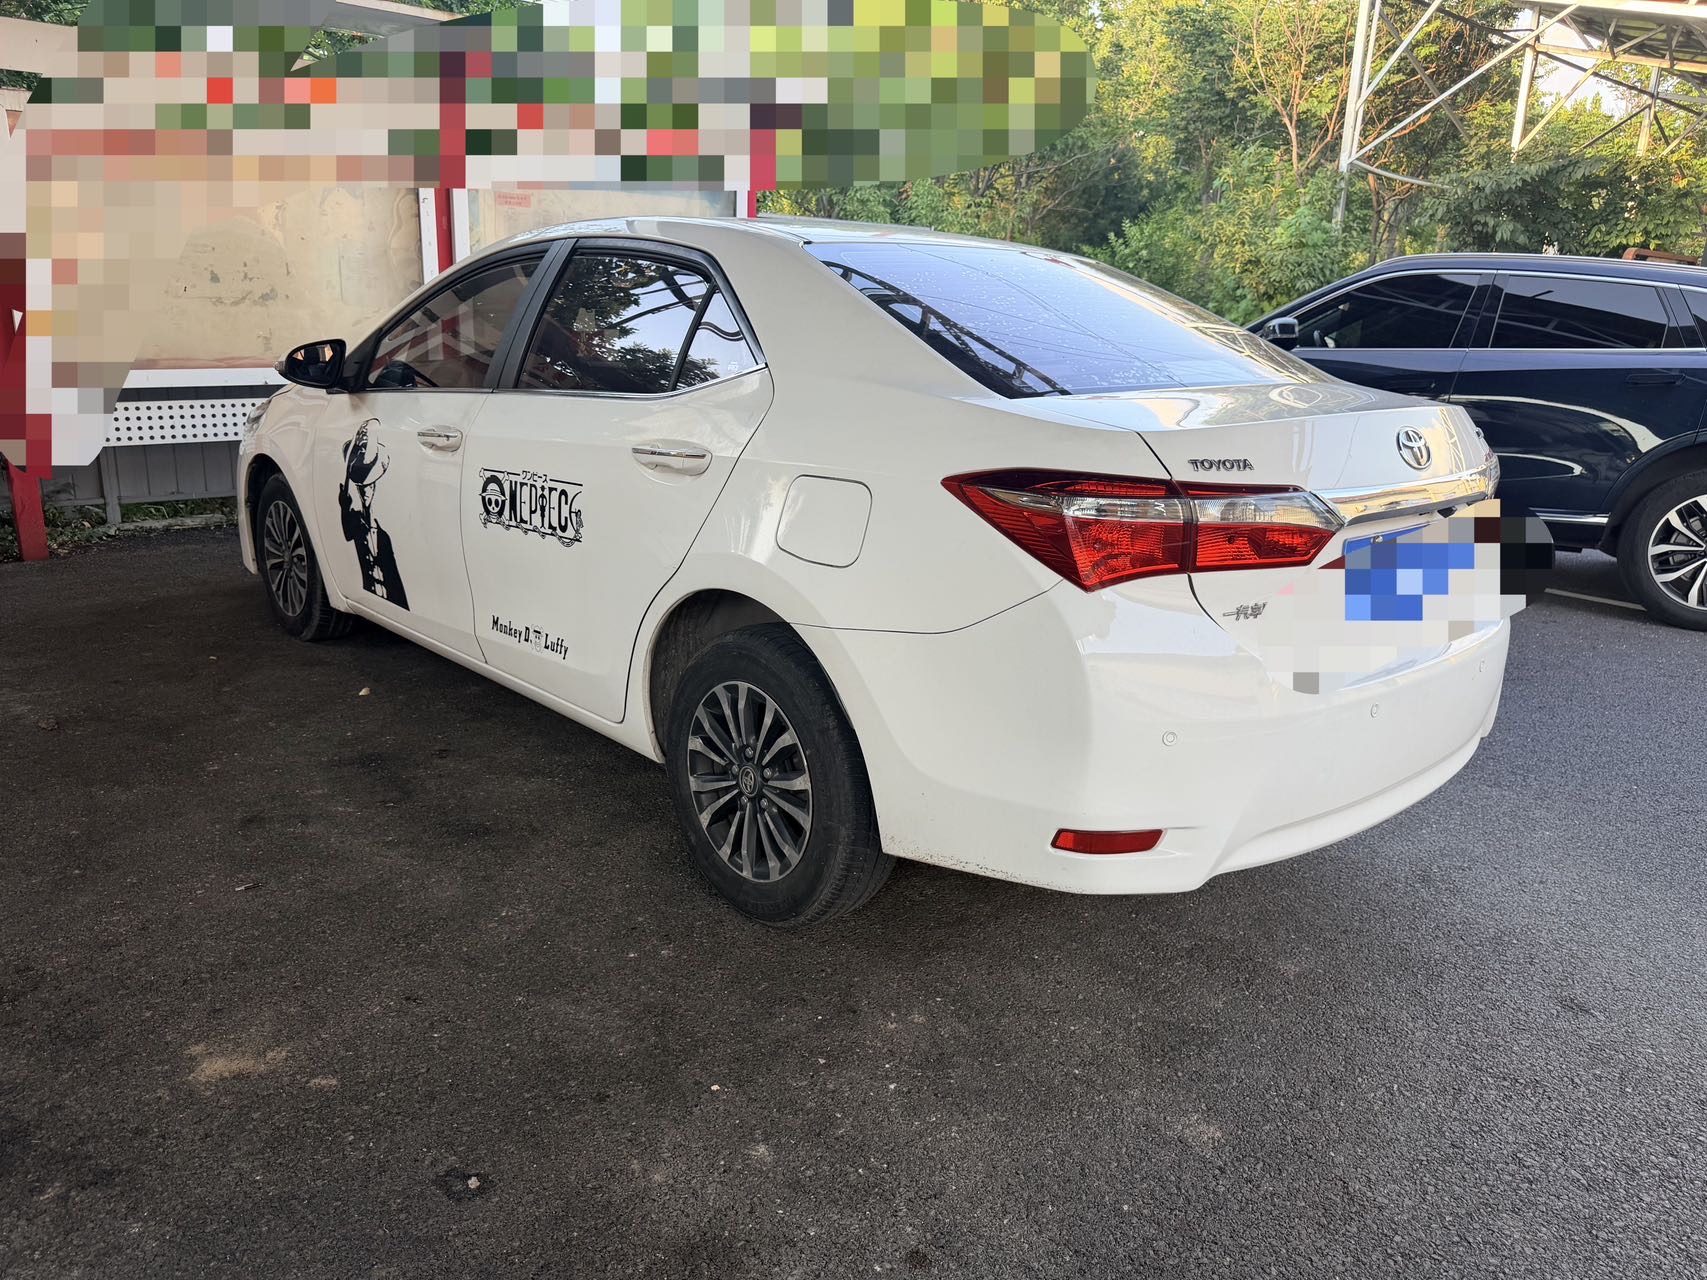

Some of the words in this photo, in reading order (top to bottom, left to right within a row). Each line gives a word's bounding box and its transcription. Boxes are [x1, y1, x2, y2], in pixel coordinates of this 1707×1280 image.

[1187, 458, 1255, 472] TOYOTA
[521, 470, 548, 484] ワンピース
[491, 614, 522, 643] Monkey
[523, 626, 533, 644] D.
[543, 633, 569, 660] Luffy
